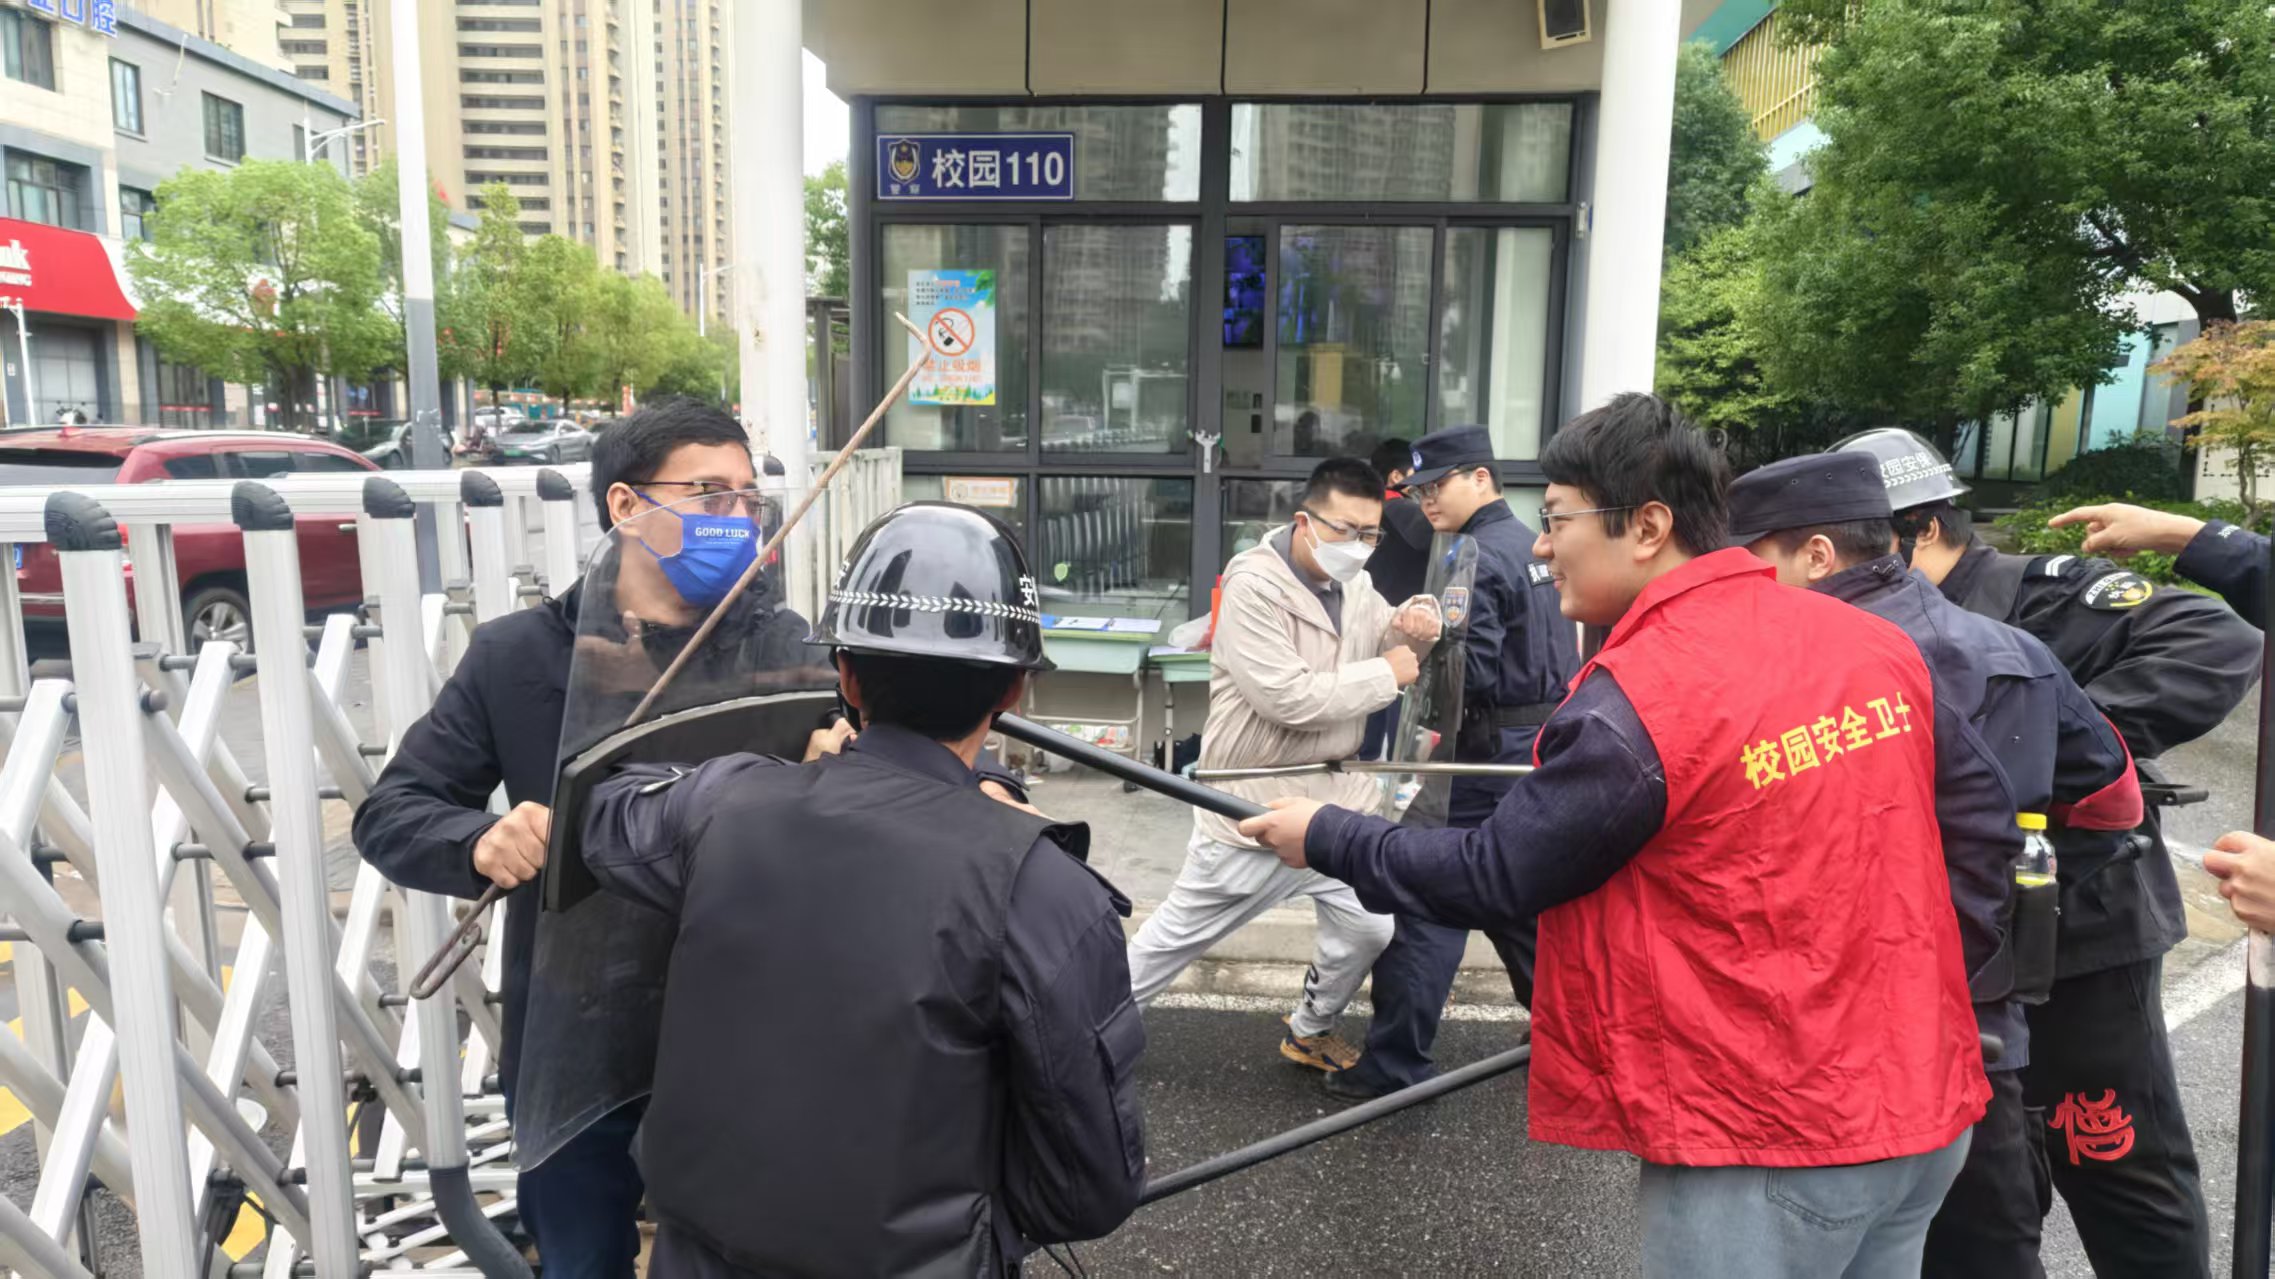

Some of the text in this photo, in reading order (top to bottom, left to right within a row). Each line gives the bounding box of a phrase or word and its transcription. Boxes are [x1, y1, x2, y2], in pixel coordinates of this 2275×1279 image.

[931, 149, 1064, 188] 校园110
[695, 527, 750, 539] GOOD LUCK
[1739, 691, 1912, 790] 校园安全卫士
